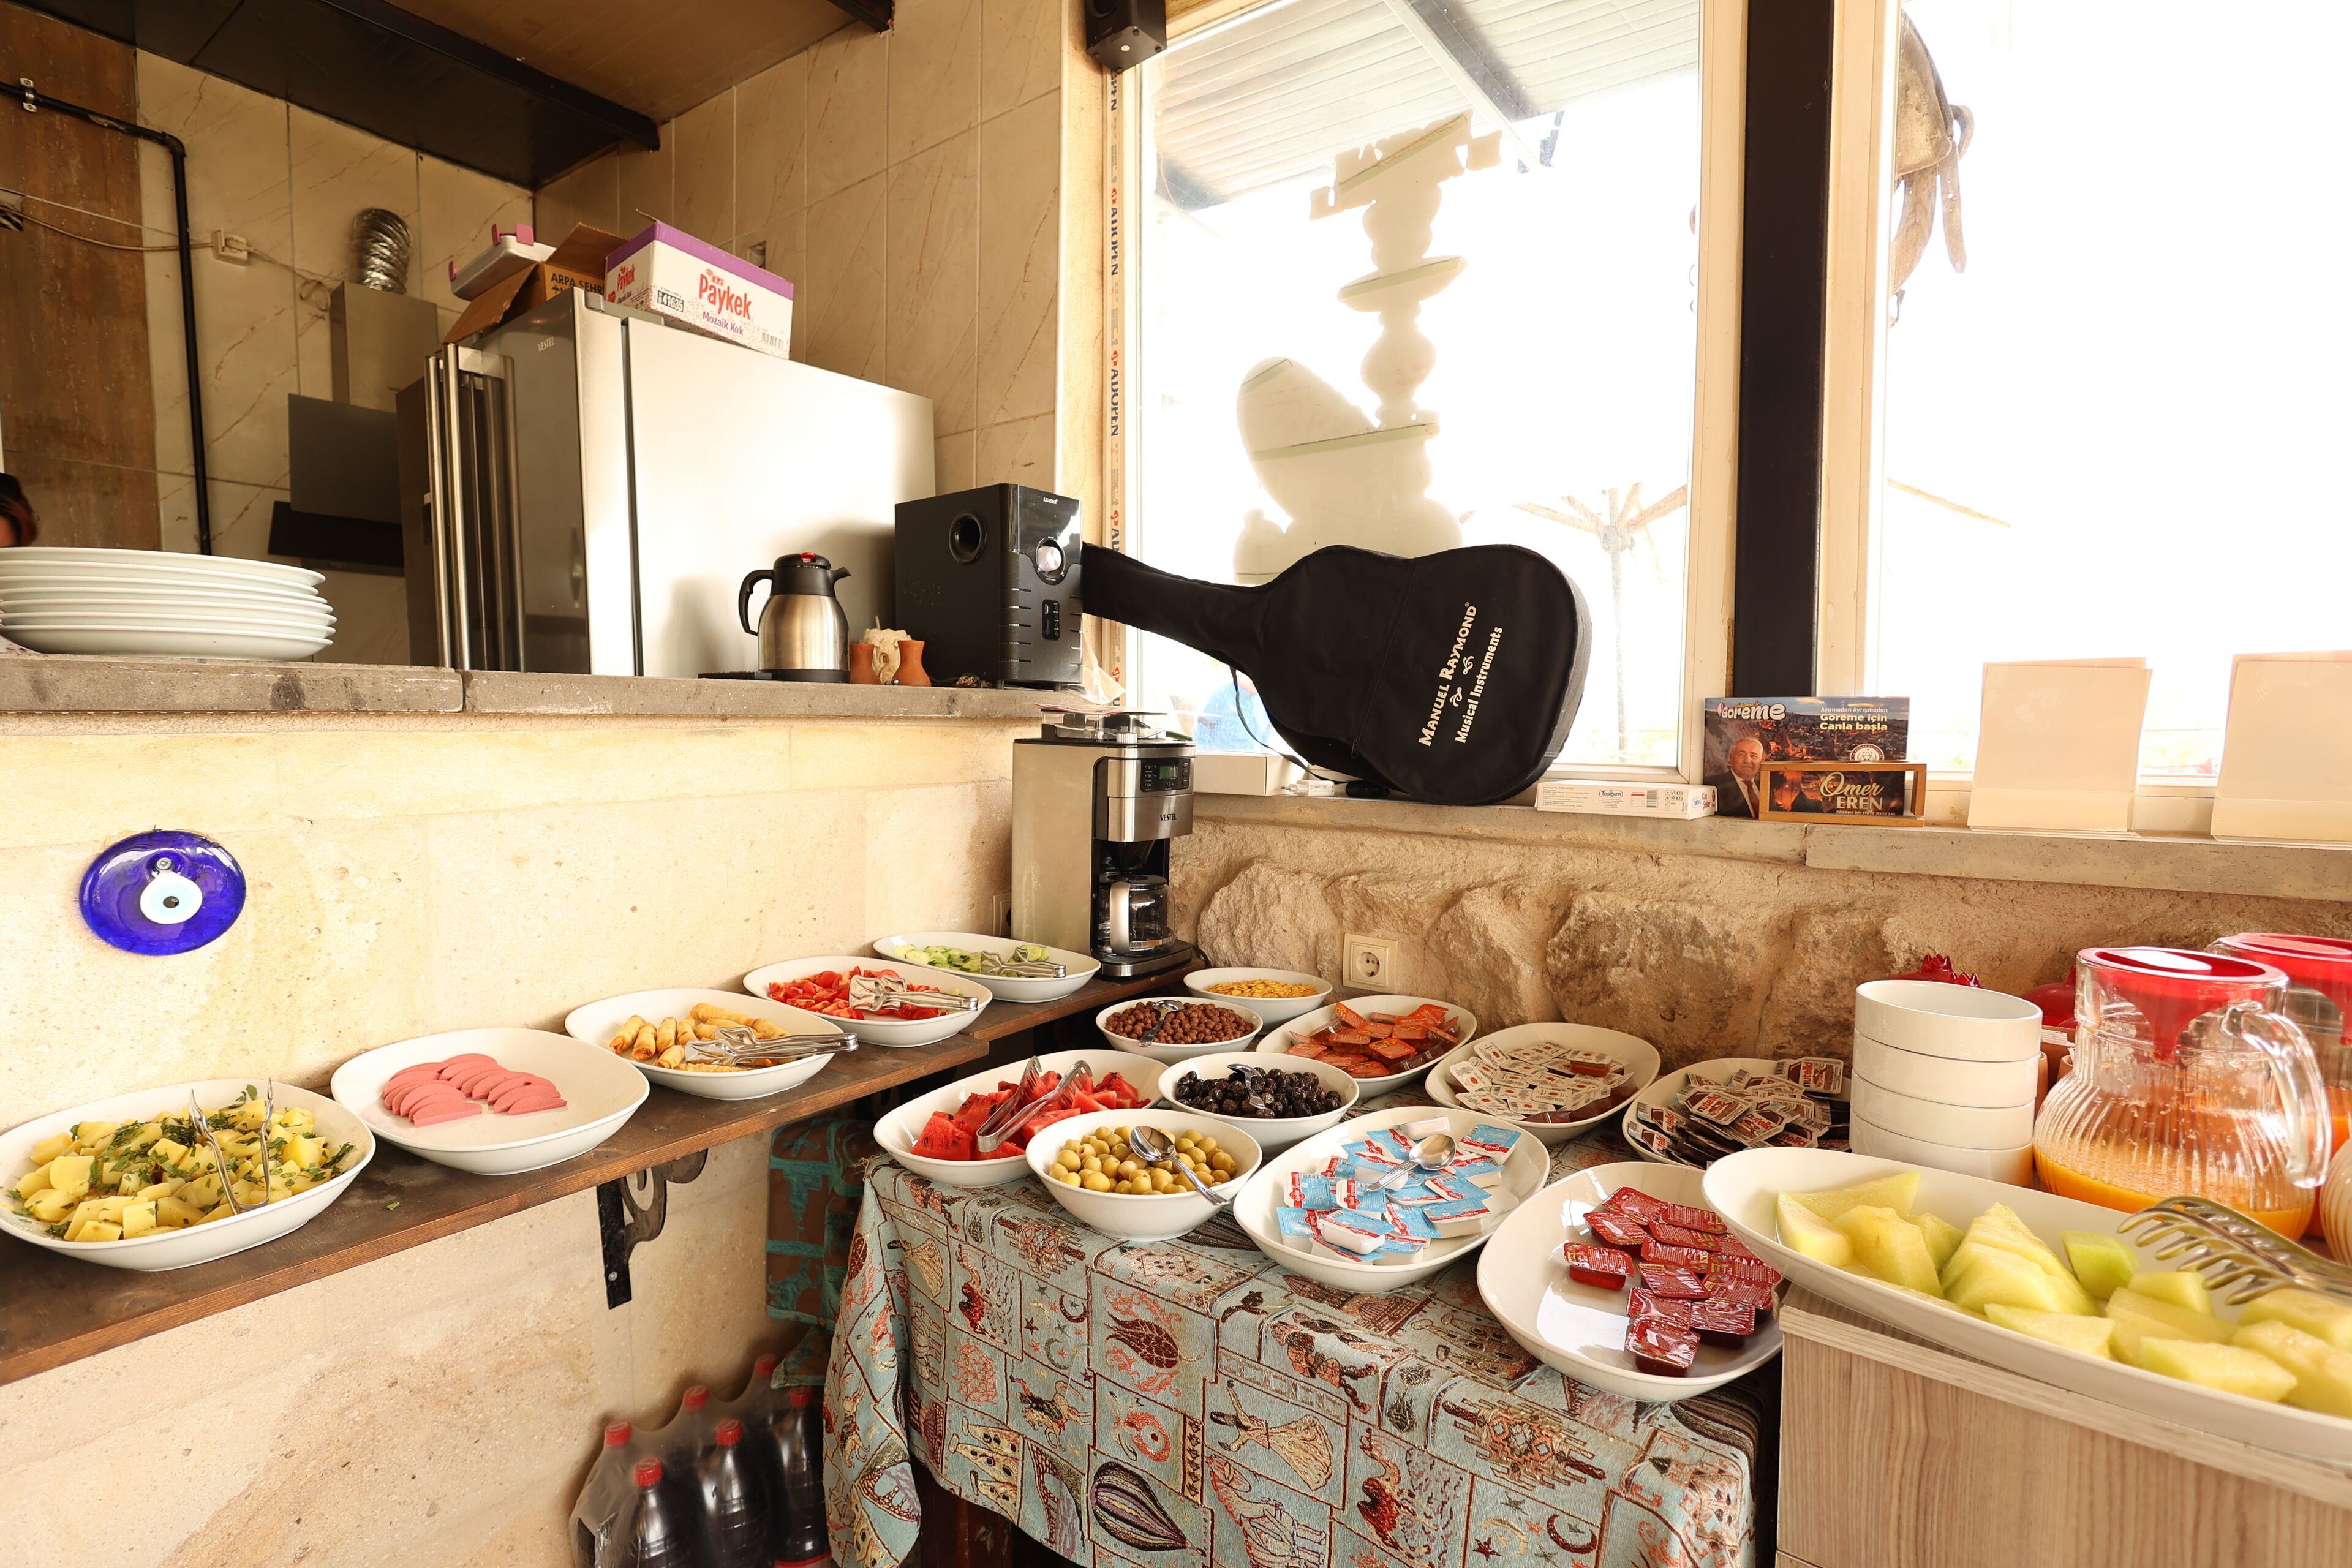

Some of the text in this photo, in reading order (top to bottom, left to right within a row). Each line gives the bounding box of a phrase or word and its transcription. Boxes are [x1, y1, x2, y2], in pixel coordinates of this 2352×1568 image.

[551, 273, 576, 287] ARPA
[662, 295, 684, 312] 41635
[699, 274, 752, 320] Paykek
[702, 311, 744, 336] Mozaik Kek
[538, 336, 555, 352] VESTEL
[1418, 605, 1477, 747] MANUEL RAYMOND
[1455, 626, 1503, 744] Musical Instruments
[1868, 714, 1888, 722] için
[1819, 722, 1888, 732] Canla başla
[1836, 796, 1882, 810] EREN
[1802, 1062, 1813, 1087] nutella
[1696, 1093, 1722, 1112] nutella
[1746, 1113, 1774, 1130] nutella
